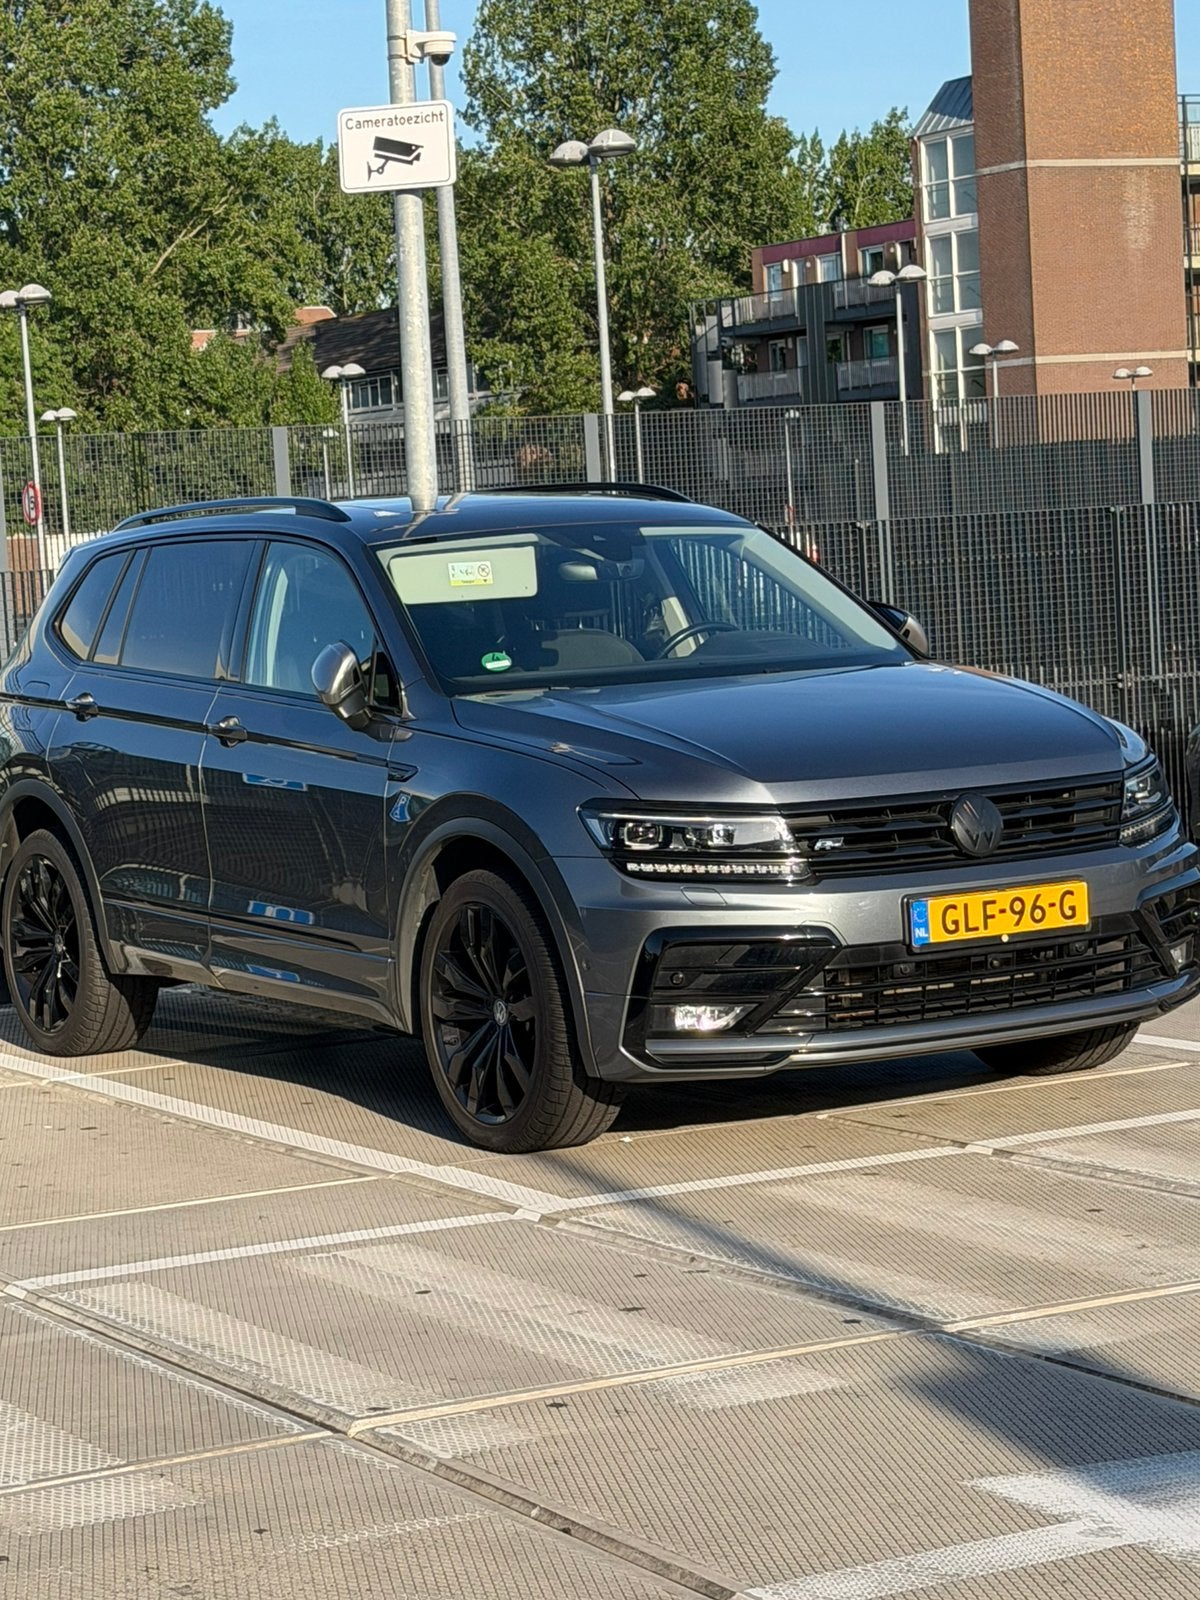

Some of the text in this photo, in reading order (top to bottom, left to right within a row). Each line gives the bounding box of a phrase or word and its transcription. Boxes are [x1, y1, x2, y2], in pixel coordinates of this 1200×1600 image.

[345, 110, 444, 130] Cameratoezicht
[941, 889, 1077, 935] GLF-96-G
[914, 927, 929, 938] NL
